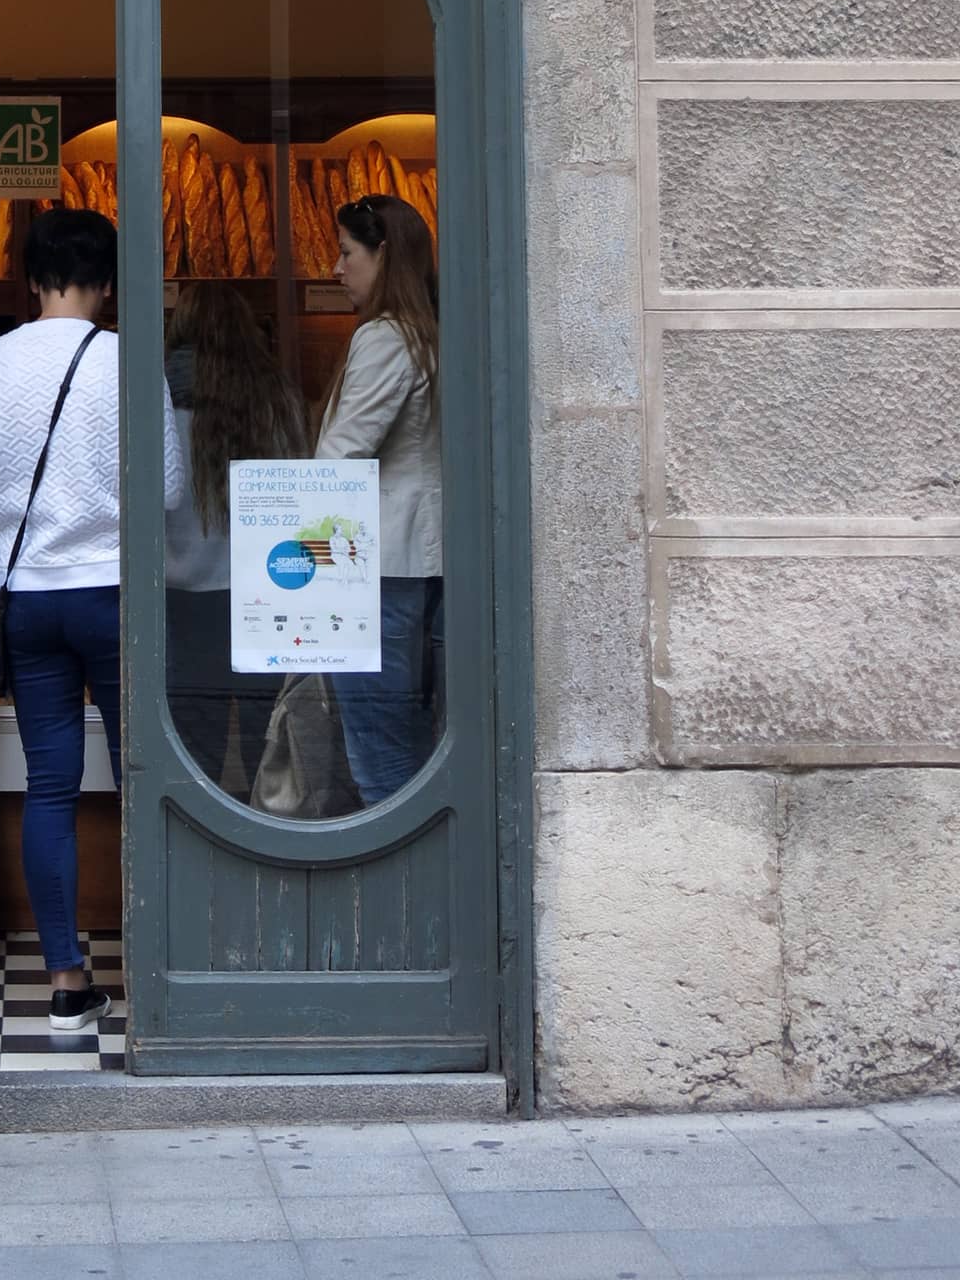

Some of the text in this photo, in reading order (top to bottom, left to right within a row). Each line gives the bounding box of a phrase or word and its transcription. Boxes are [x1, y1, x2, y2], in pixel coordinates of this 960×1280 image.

[238, 468, 297, 479] COMPARTEIX
[299, 468, 312, 478] LA
[238, 481, 297, 492] COMPARTEIX
[299, 482, 318, 492] LES
[238, 515, 301, 526] 900 365 222
[281, 656, 298, 664] Obra
[299, 656, 318, 664] Social
